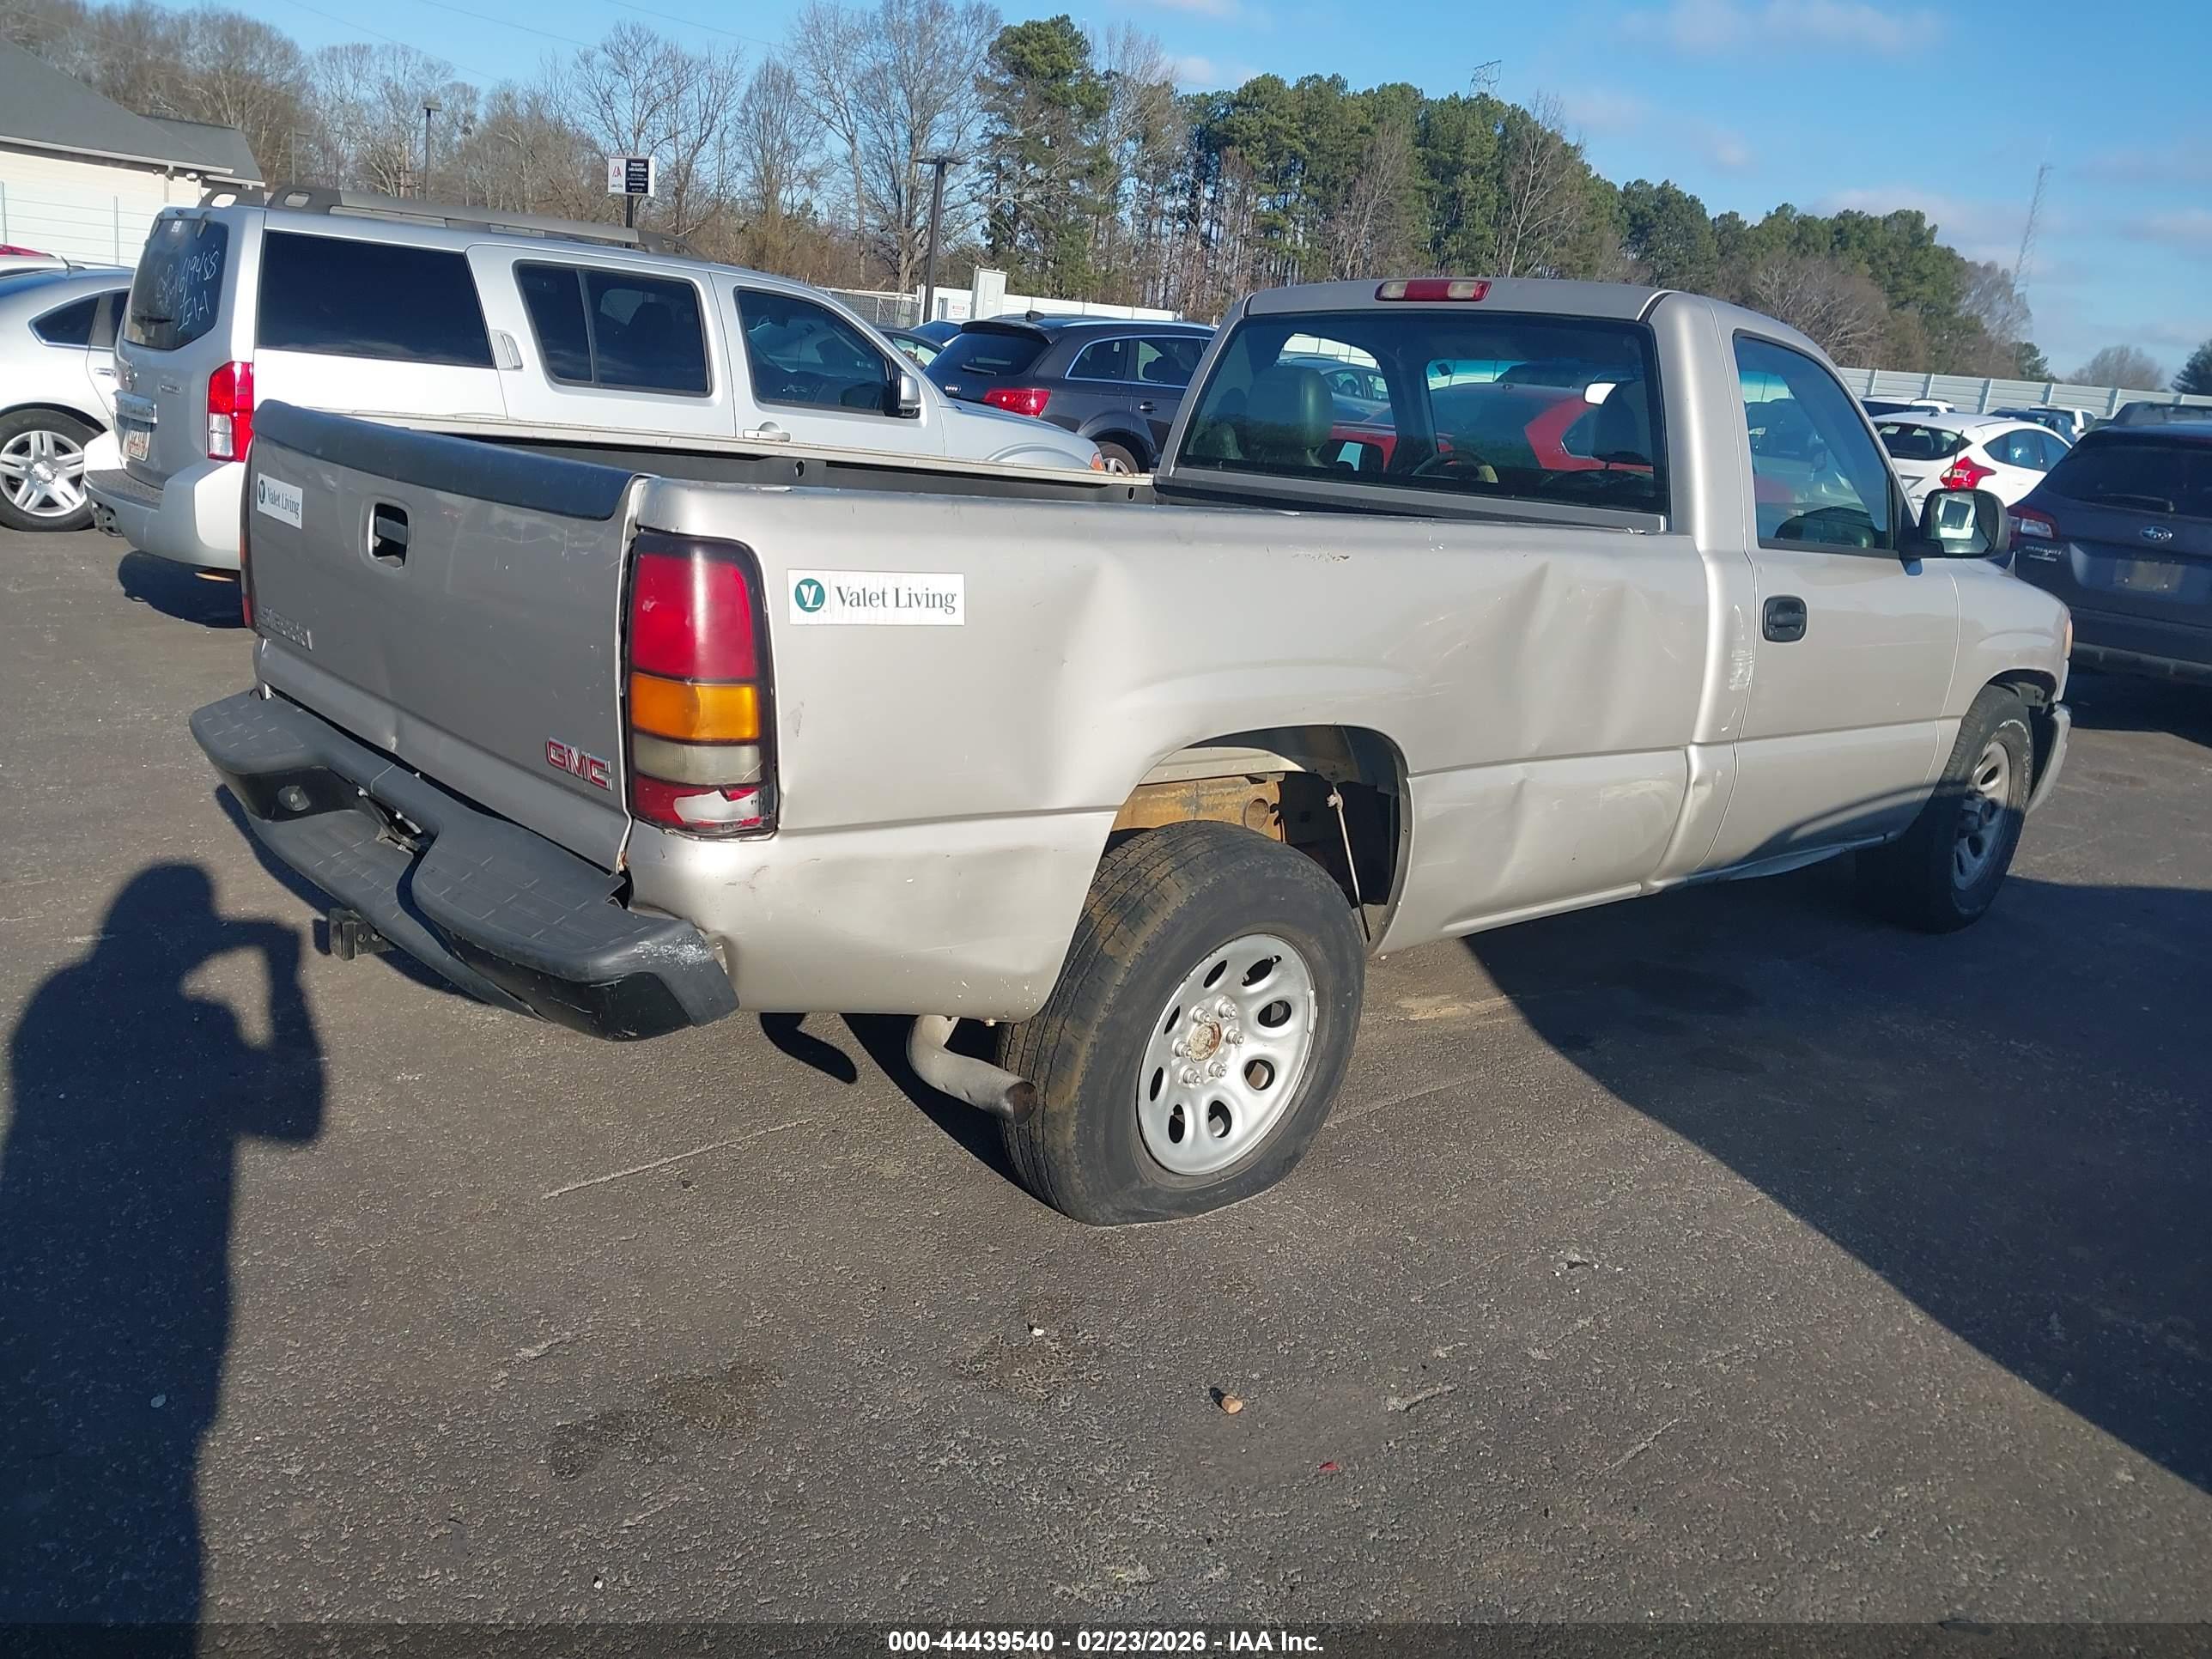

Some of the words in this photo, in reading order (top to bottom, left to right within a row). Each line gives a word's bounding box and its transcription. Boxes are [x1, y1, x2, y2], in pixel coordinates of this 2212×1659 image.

[267, 487, 281, 507] Valet
[282, 493, 300, 520] Living
[835, 586, 888, 608] Valet
[893, 586, 957, 615] Living
[546, 737, 612, 791] GMC
